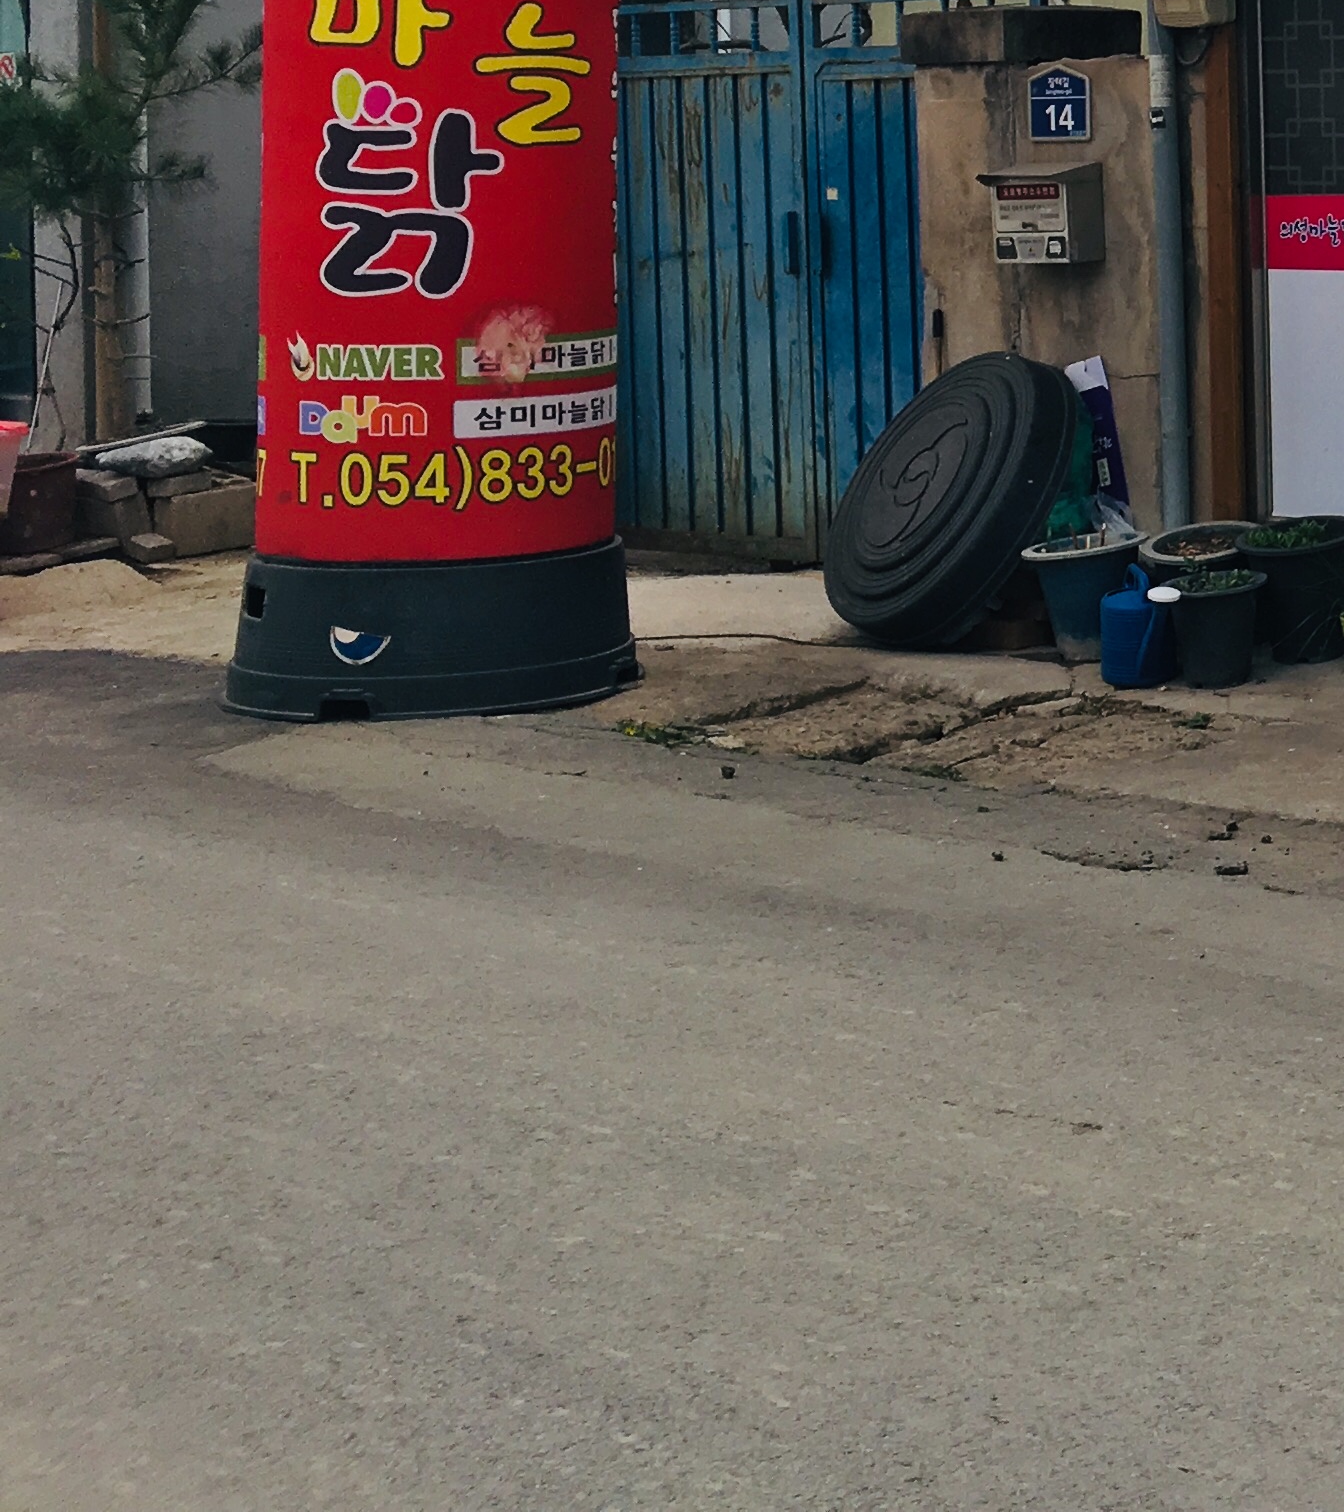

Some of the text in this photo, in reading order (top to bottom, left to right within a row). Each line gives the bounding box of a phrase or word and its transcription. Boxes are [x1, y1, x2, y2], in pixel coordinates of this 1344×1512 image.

[1045, 104, 1075, 131] 14
[314, 88, 505, 300] 닭
[316, 343, 445, 382] NAVER
[299, 395, 428, 444] Daum
[473, 396, 606, 431] 삼미마늘닭
